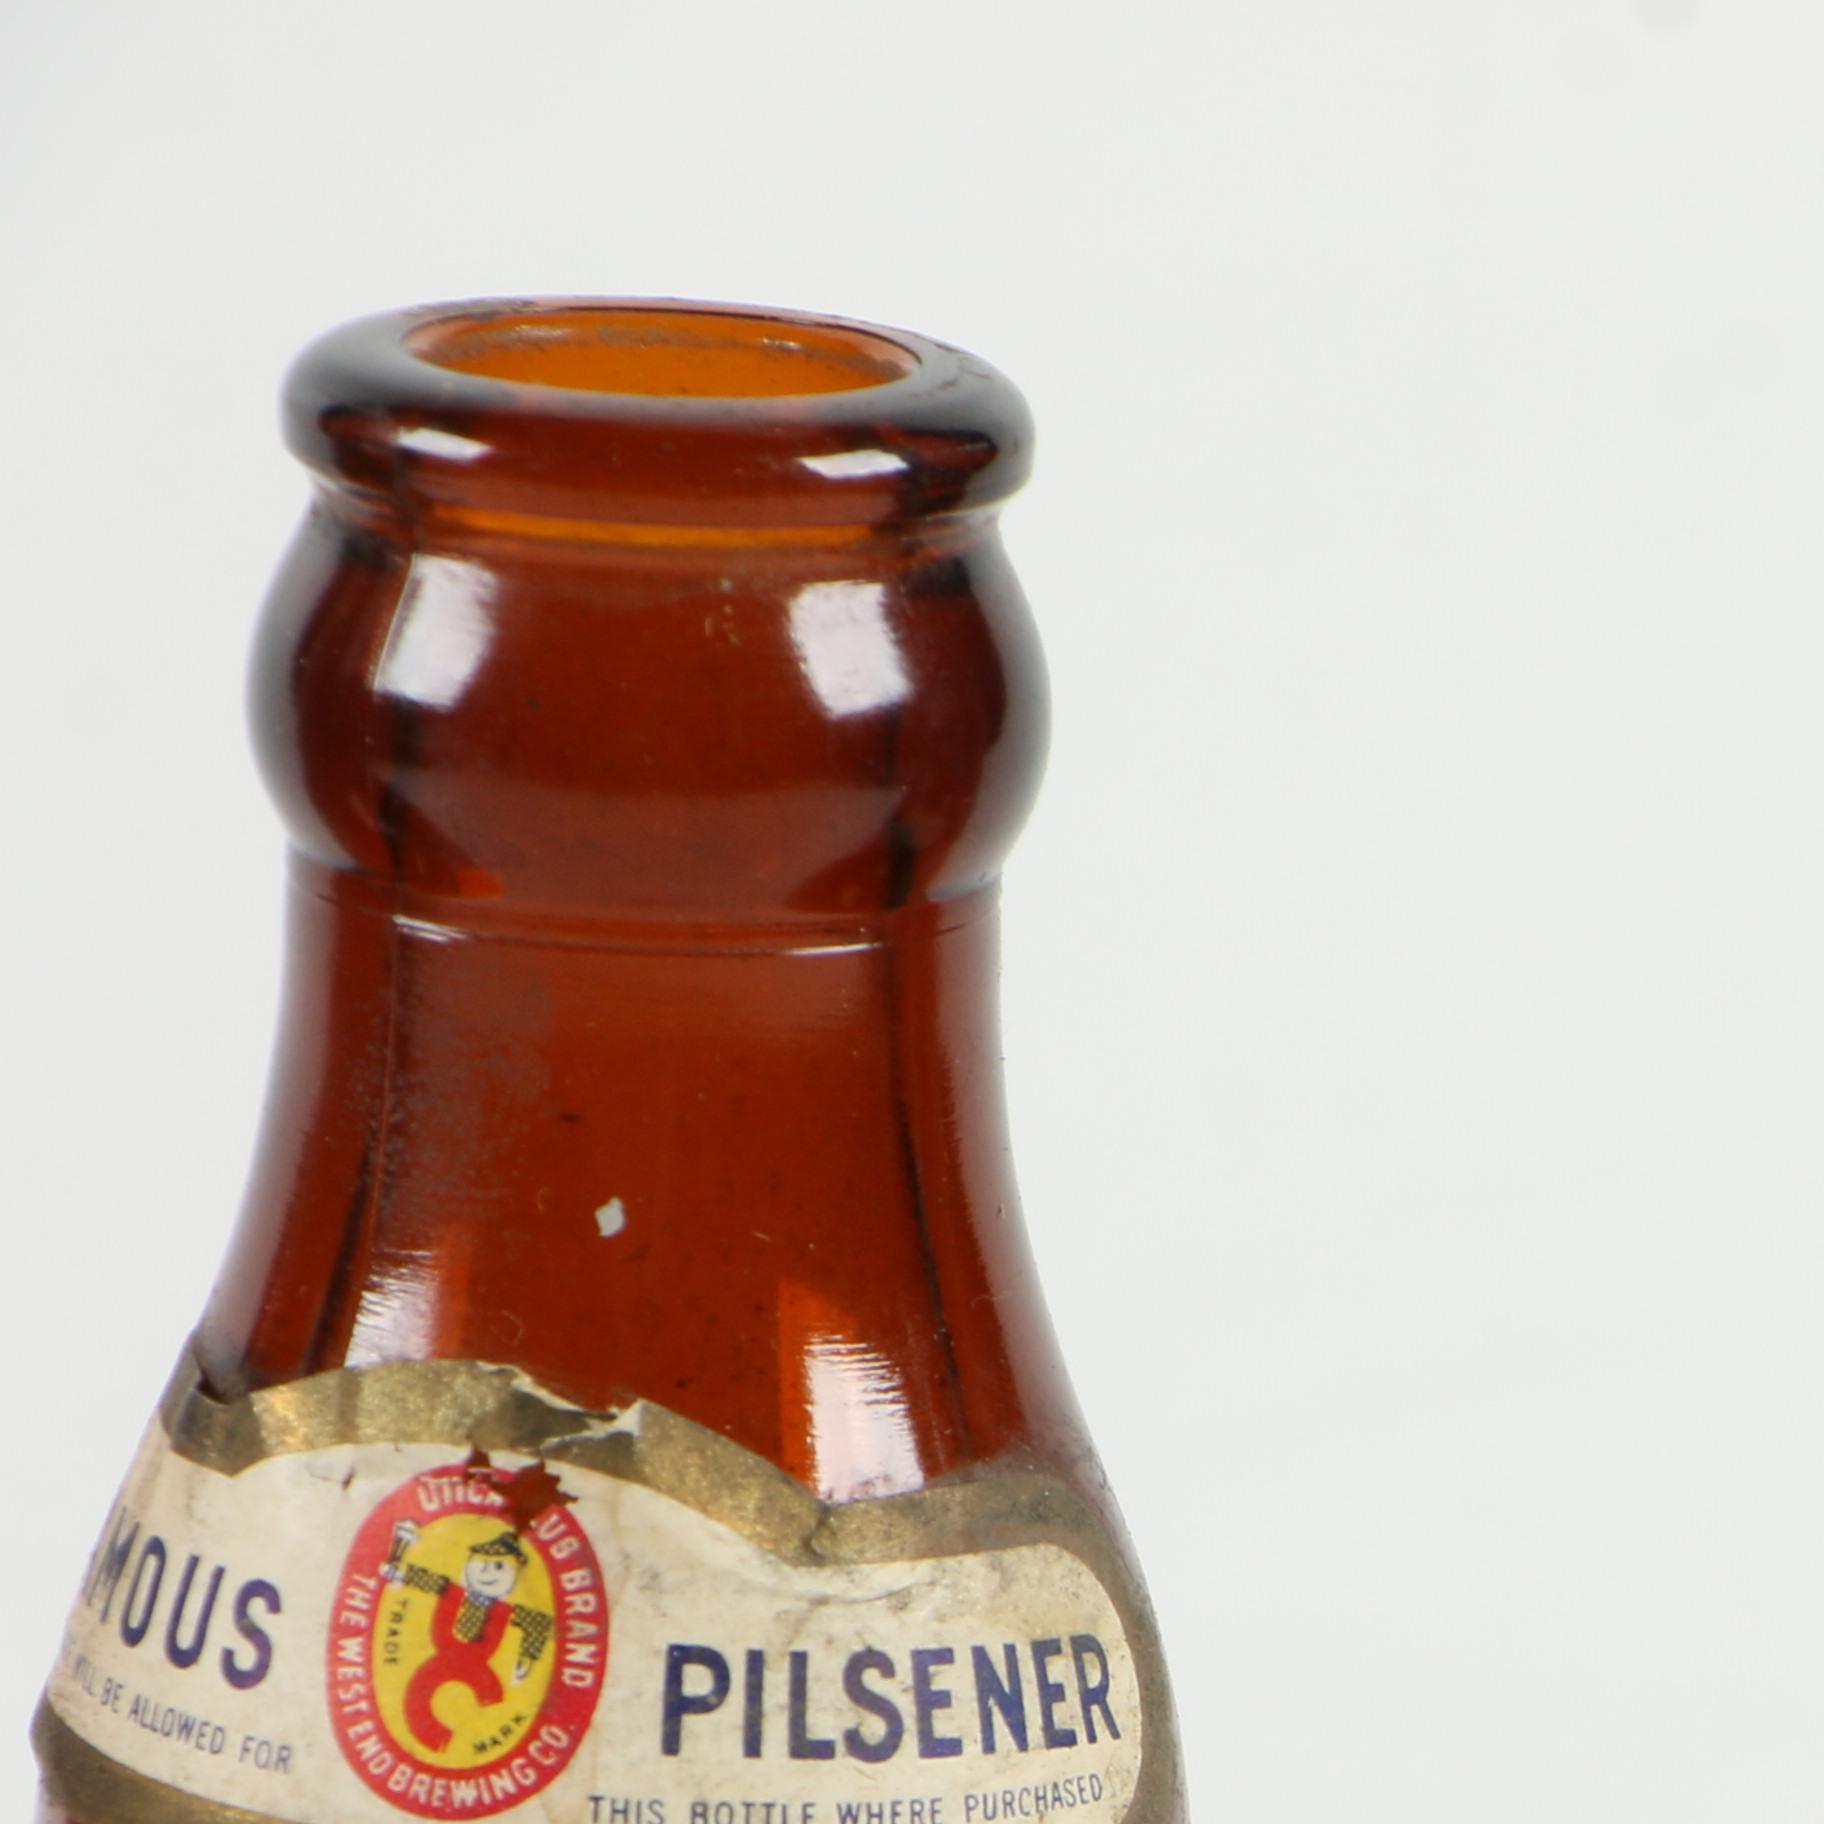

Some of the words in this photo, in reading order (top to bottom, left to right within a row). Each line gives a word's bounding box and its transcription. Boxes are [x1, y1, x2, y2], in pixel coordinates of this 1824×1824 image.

[85, 1505, 282, 1690] MOUS
[340, 1574, 378, 1629] THE
[560, 1568, 598, 1689] BRAND
[384, 1598, 408, 1666] TRADE
[337, 1636, 371, 1714] WEST
[660, 1633, 1121, 1764] PILSENER
[100, 1677, 124, 1713] BE
[127, 1693, 226, 1755] ALLOWED
[238, 1735, 293, 1774] FOR
[347, 1719, 393, 1776] END
[473, 1713, 528, 1754] MARK
[387, 1757, 538, 1809] BREWING
[964, 1773, 1102, 1824] PURCHASED
